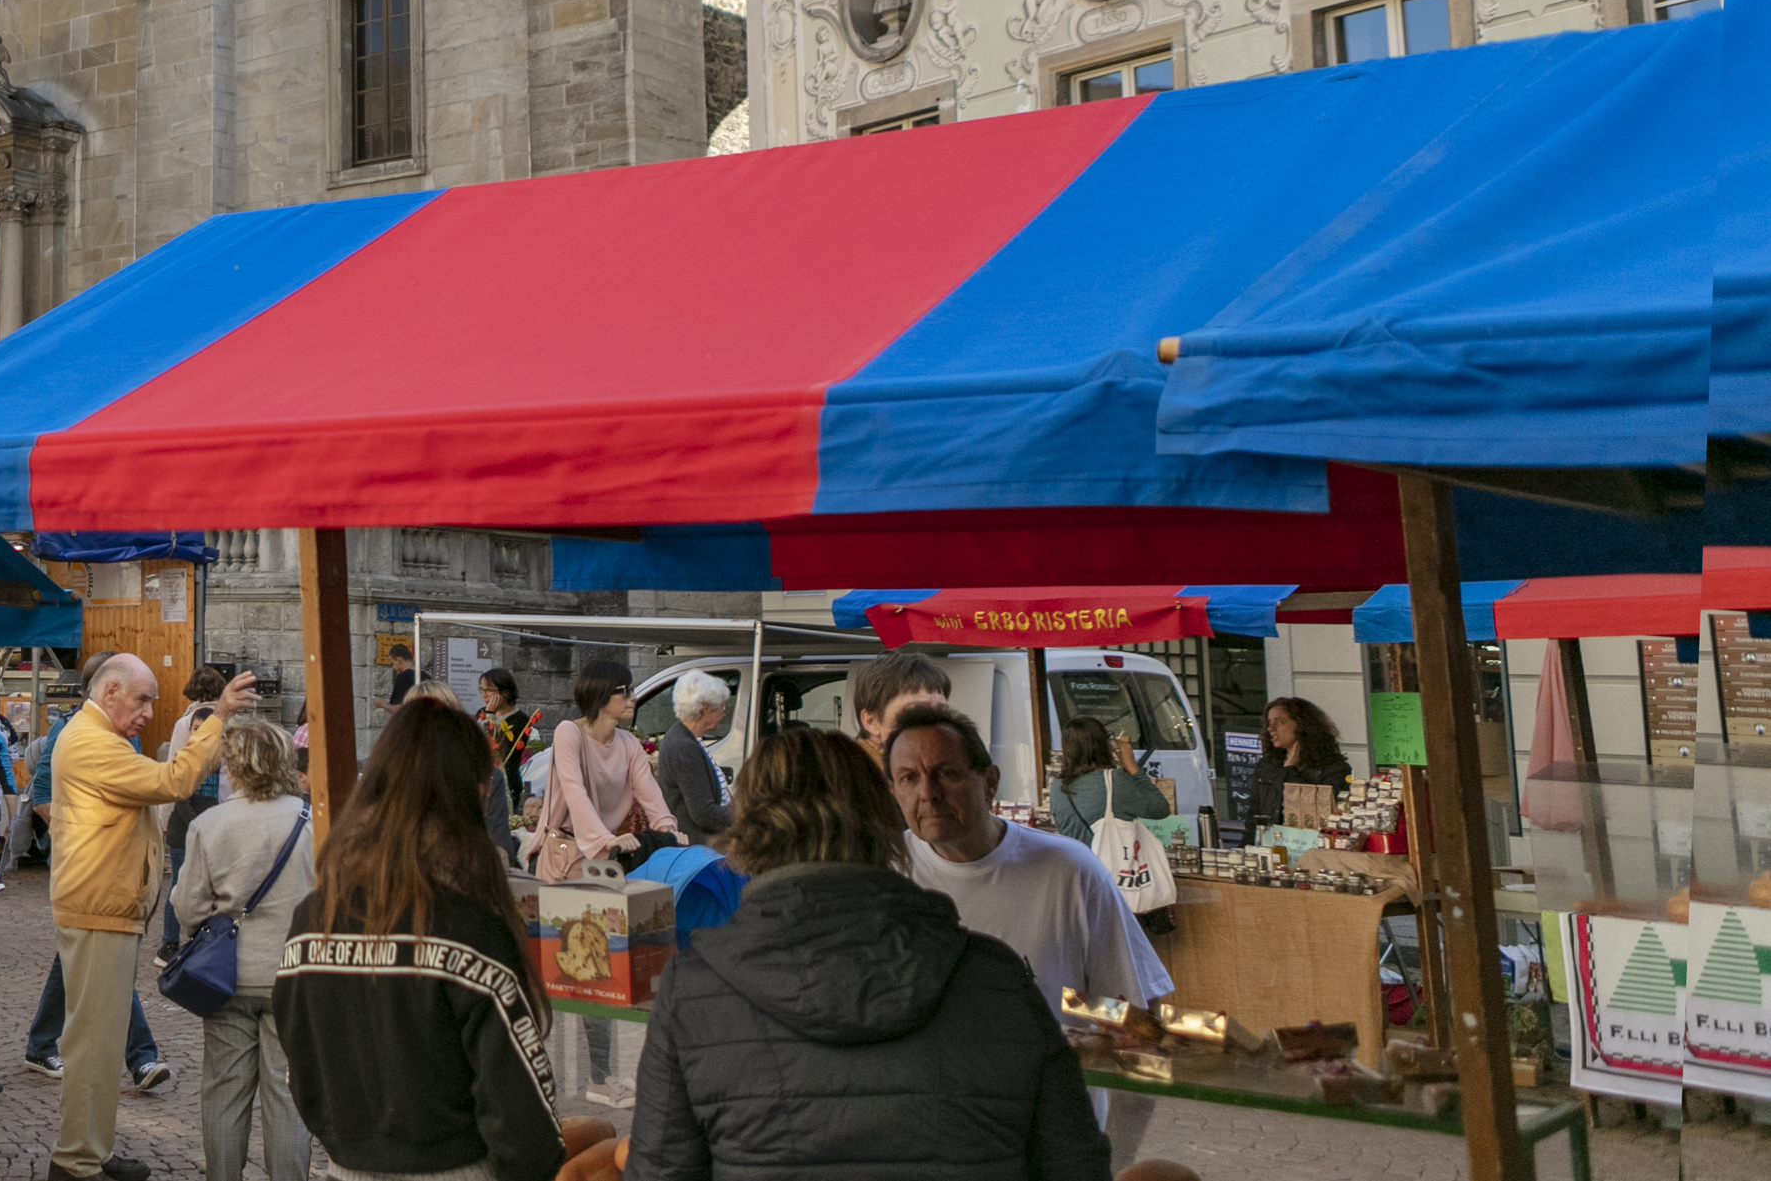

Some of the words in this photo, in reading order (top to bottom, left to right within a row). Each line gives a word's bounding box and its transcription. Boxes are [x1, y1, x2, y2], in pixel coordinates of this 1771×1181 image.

[1093, 9, 1127, 29] TASSO
[872, 72, 905, 89] GALILEO
[933, 614, 964, 629] mini
[973, 608, 1133, 631] ERBORISTERIA
[1696, 1013, 1744, 1033] F.LLI
[1610, 1024, 1657, 1043] F.LLI
